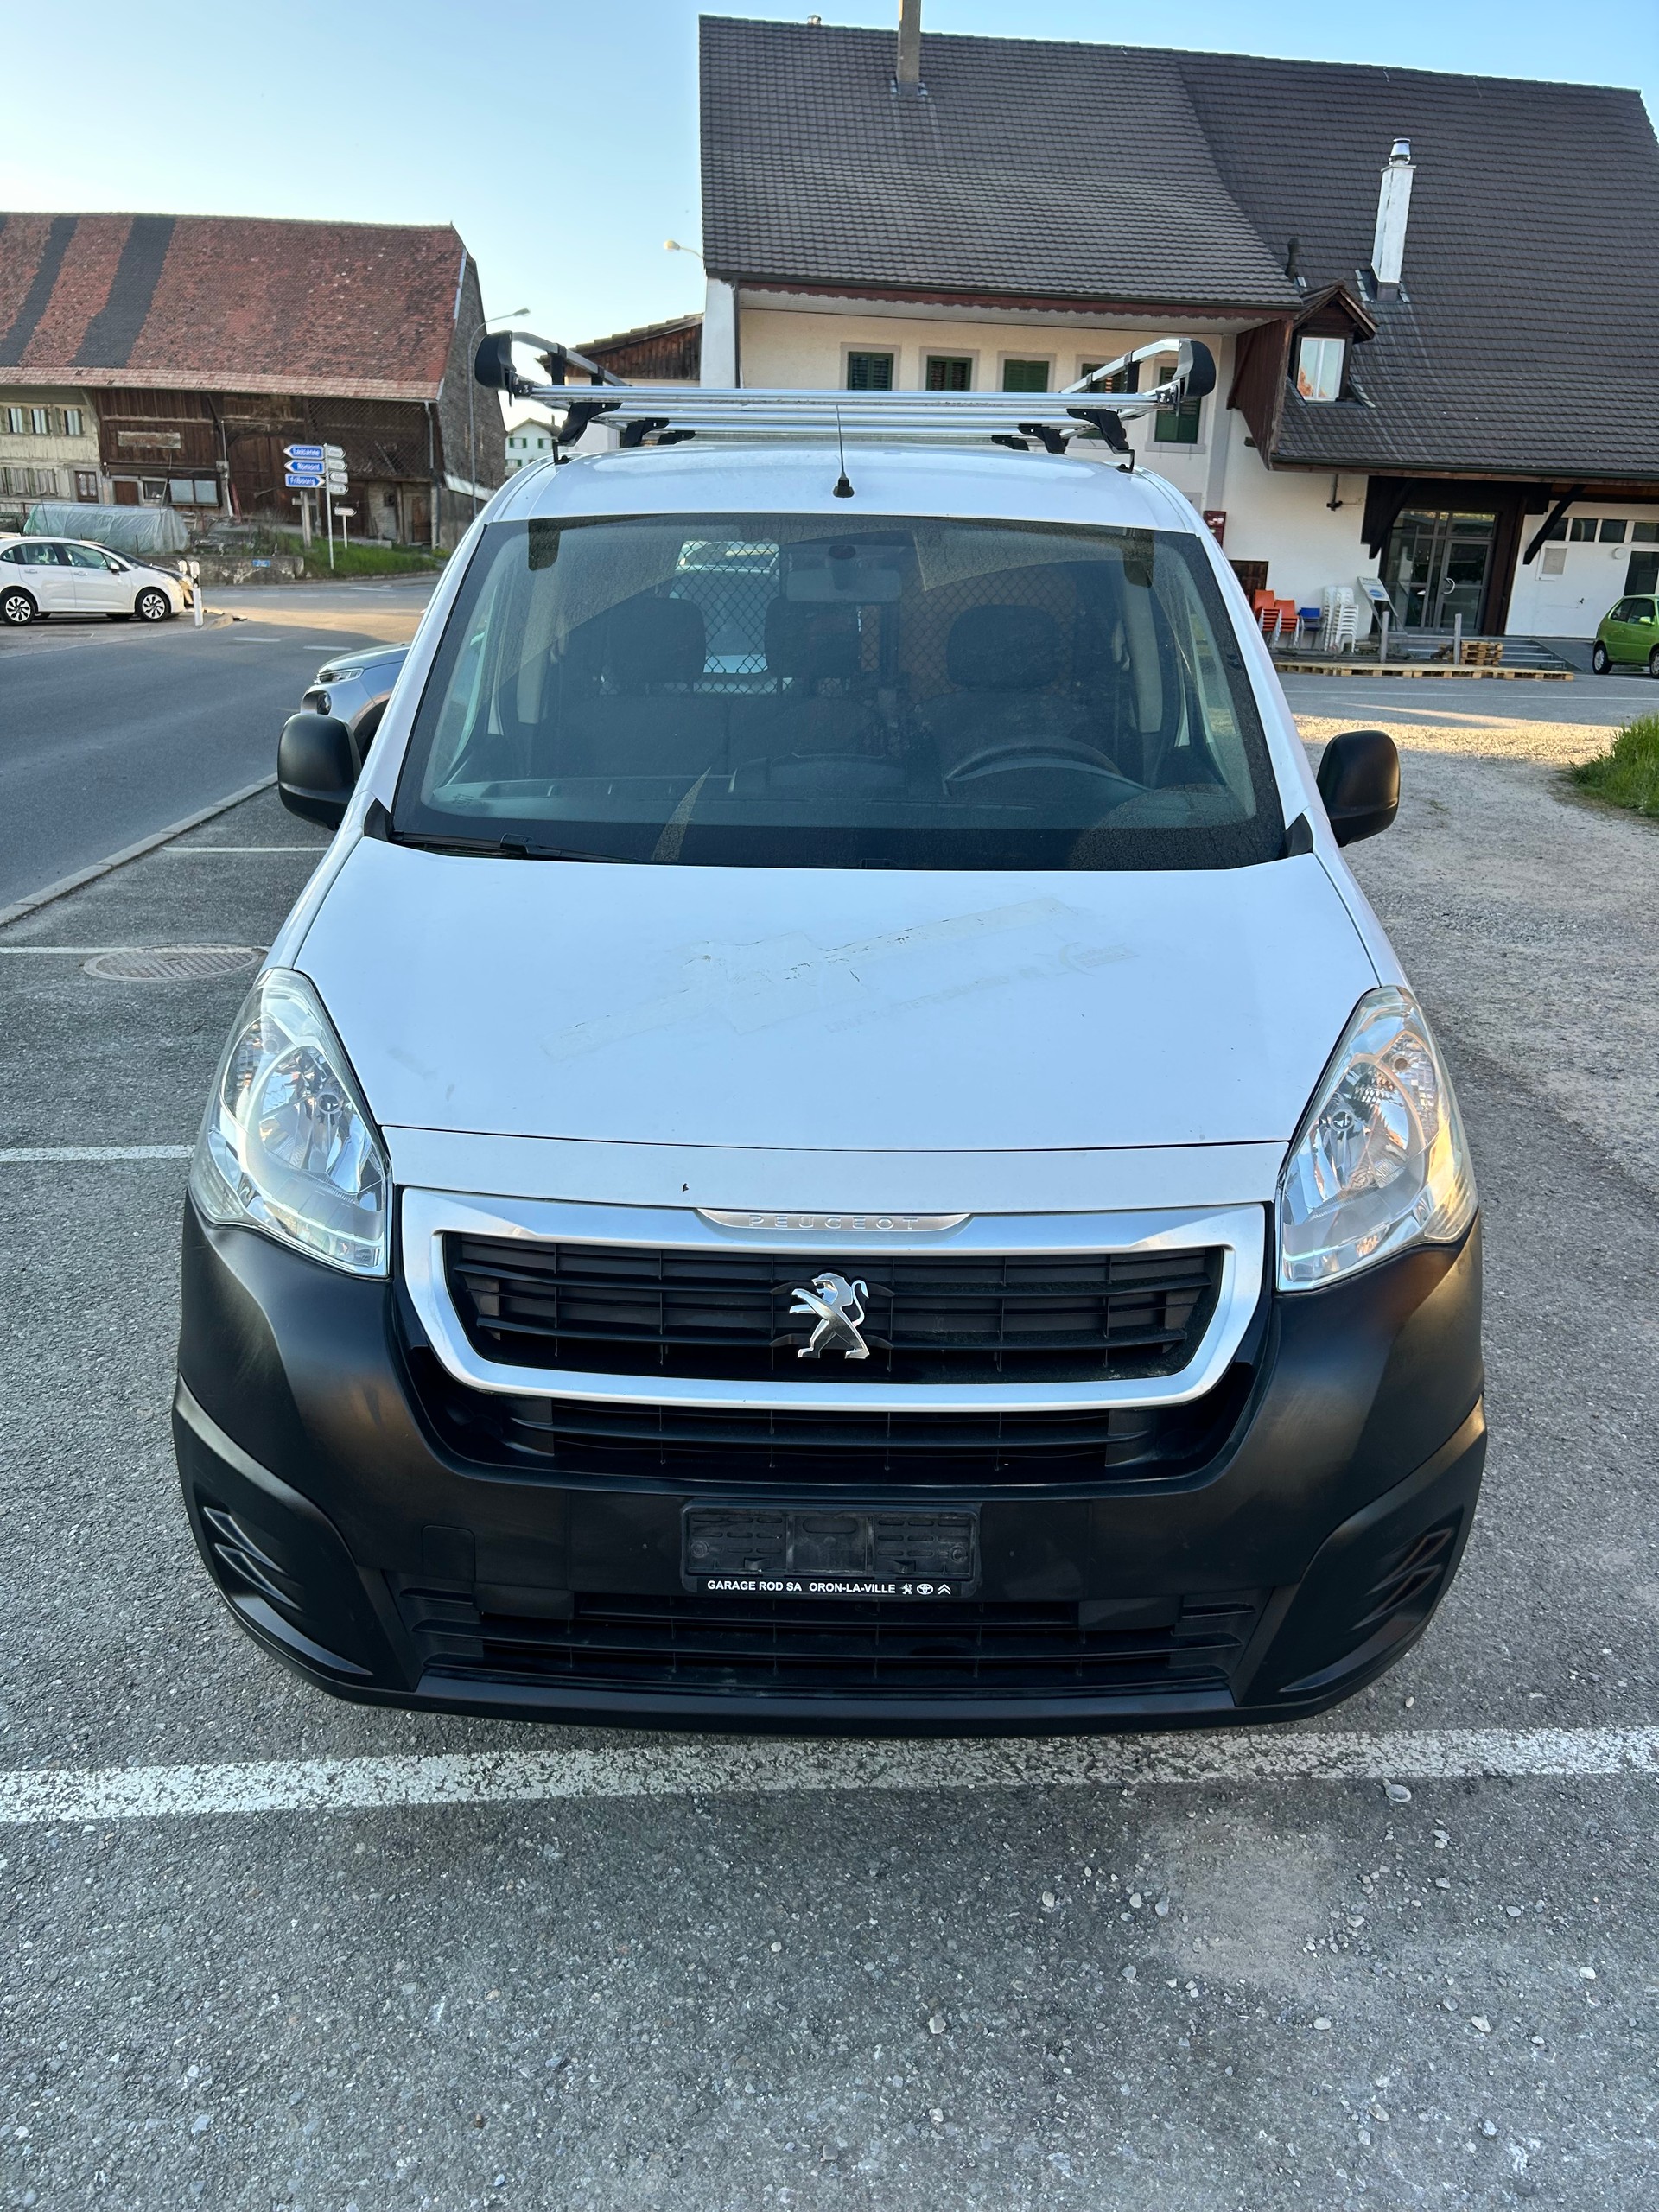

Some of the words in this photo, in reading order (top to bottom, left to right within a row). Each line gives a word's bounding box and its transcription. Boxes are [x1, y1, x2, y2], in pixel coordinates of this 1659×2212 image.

[292, 447, 320, 456] Lausanne
[296, 462, 320, 472] Romont
[289, 475, 316, 486] Fribourg
[748, 1214, 918, 1230] PEUGEOT
[707, 1580, 756, 1591] GARAGE
[759, 1581, 784, 1592] ROD
[785, 1582, 803, 1592] SA
[809, 1582, 896, 1593] ORON-LA-VILLE
